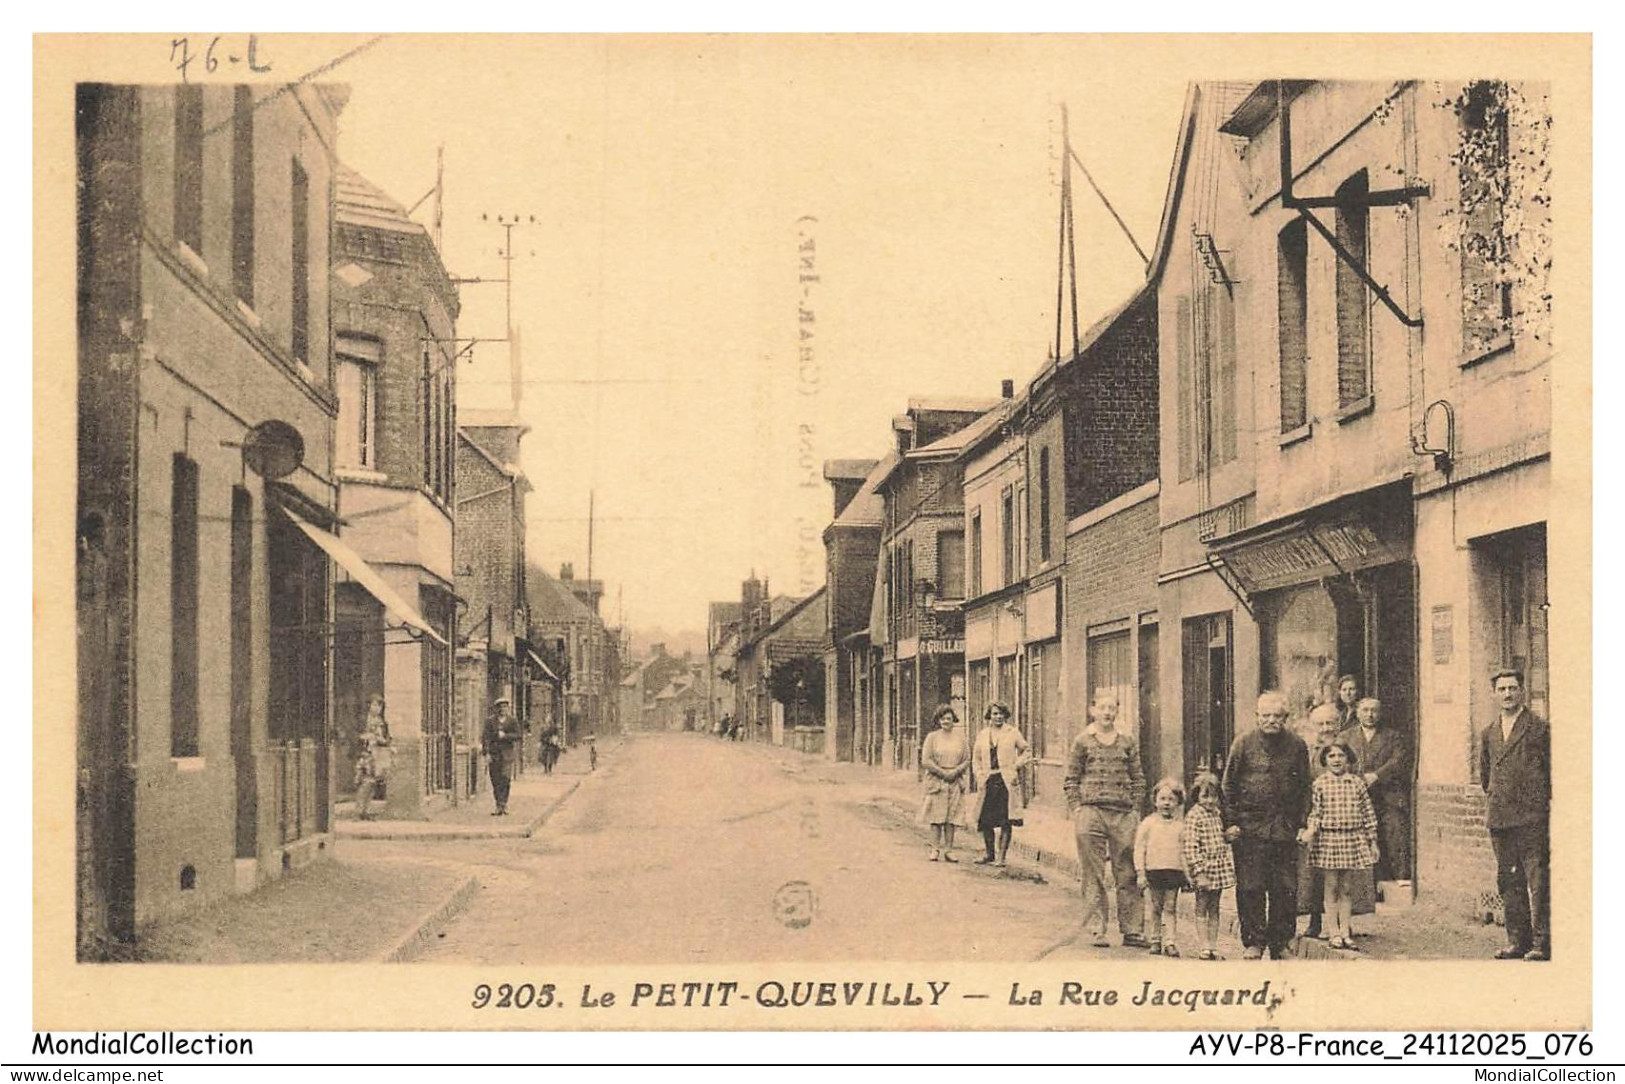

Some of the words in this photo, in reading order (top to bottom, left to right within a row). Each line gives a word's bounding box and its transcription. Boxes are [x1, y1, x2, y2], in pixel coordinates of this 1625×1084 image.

[472, 983, 563, 1009] 9205.
[581, 984, 615, 1008] Le
[631, 981, 950, 1007] PETIT-QUEVILLY
[1009, 982, 1043, 1006] La
[1060, 982, 1118, 1006] Rue
